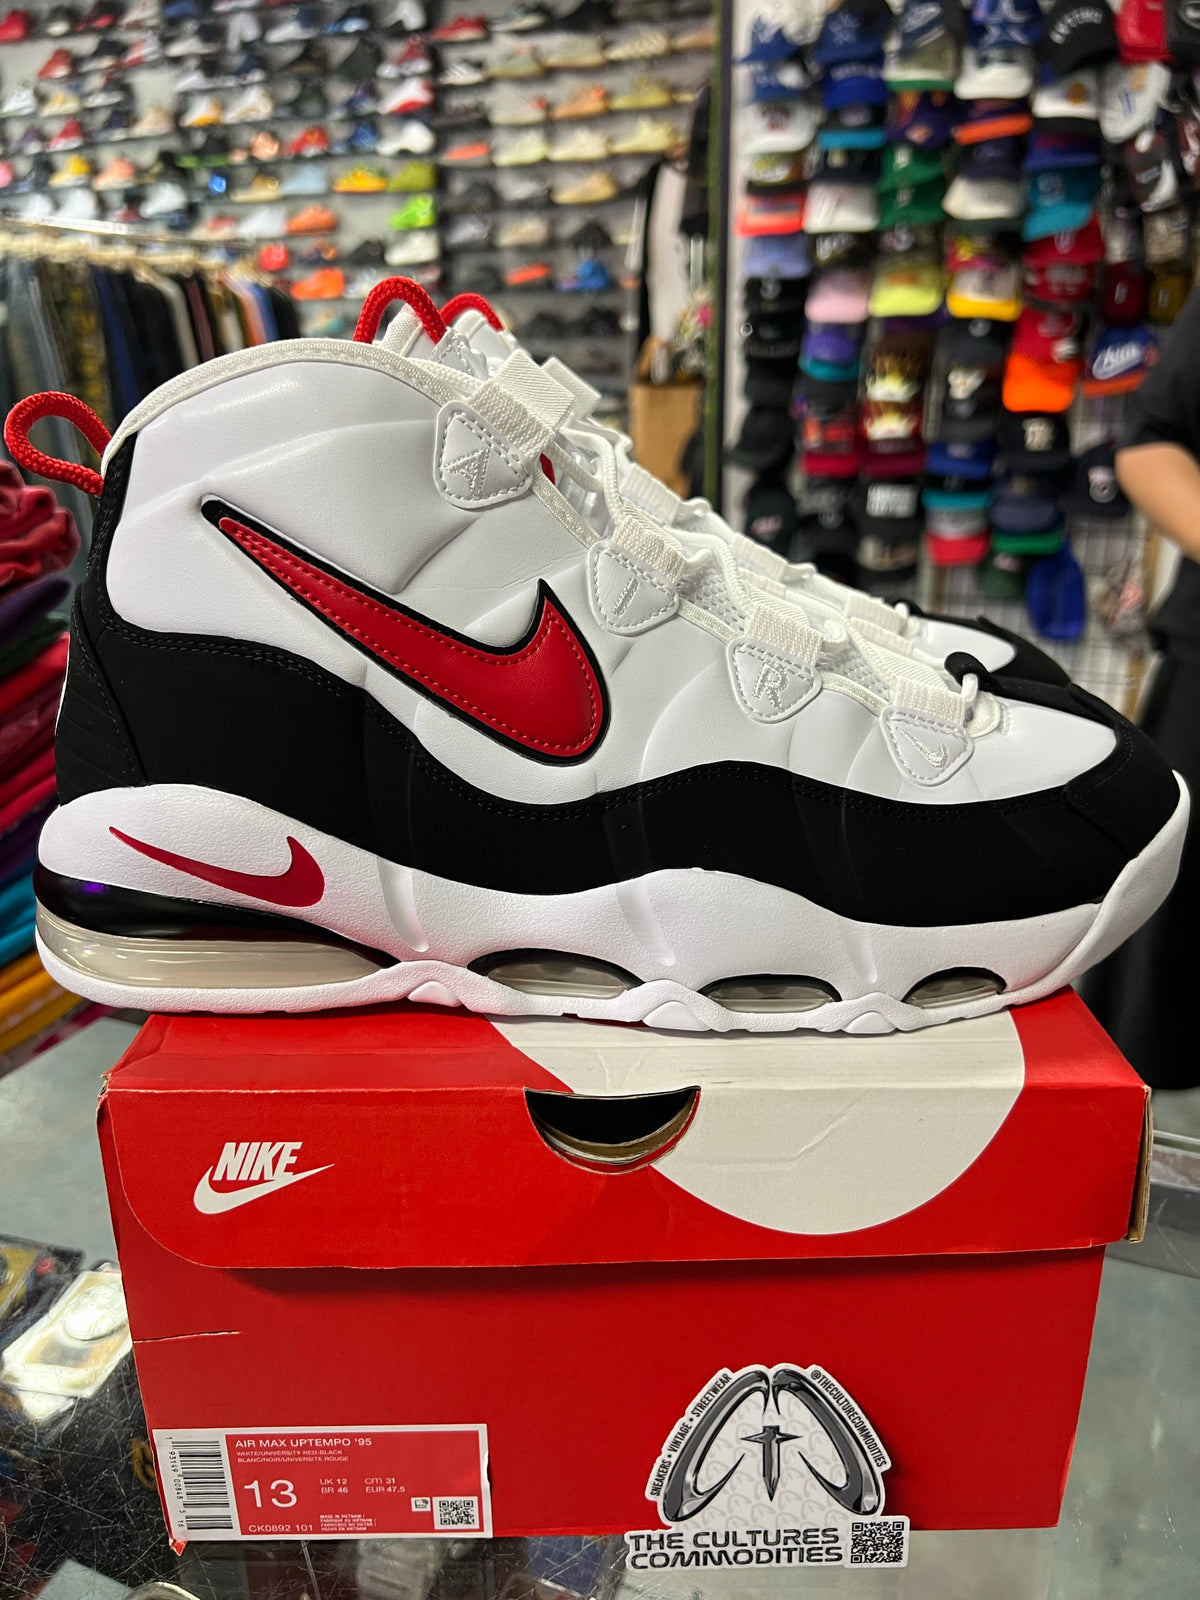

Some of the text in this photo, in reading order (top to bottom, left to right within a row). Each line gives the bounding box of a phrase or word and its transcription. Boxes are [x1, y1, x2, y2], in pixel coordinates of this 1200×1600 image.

[212, 1141, 303, 1181] NIKE
[236, 1438, 372, 1448] AIR MAX UPTEMPO '95
[650, 1372, 732, 1498] SNEAKERS VINTAGE STREETWEAR
[244, 1479, 298, 1508] 13
[248, 1524, 292, 1533] CK0892
[629, 1528, 840, 1551] THE CULTURES
[631, 1546, 843, 1570] COMMODITIES
